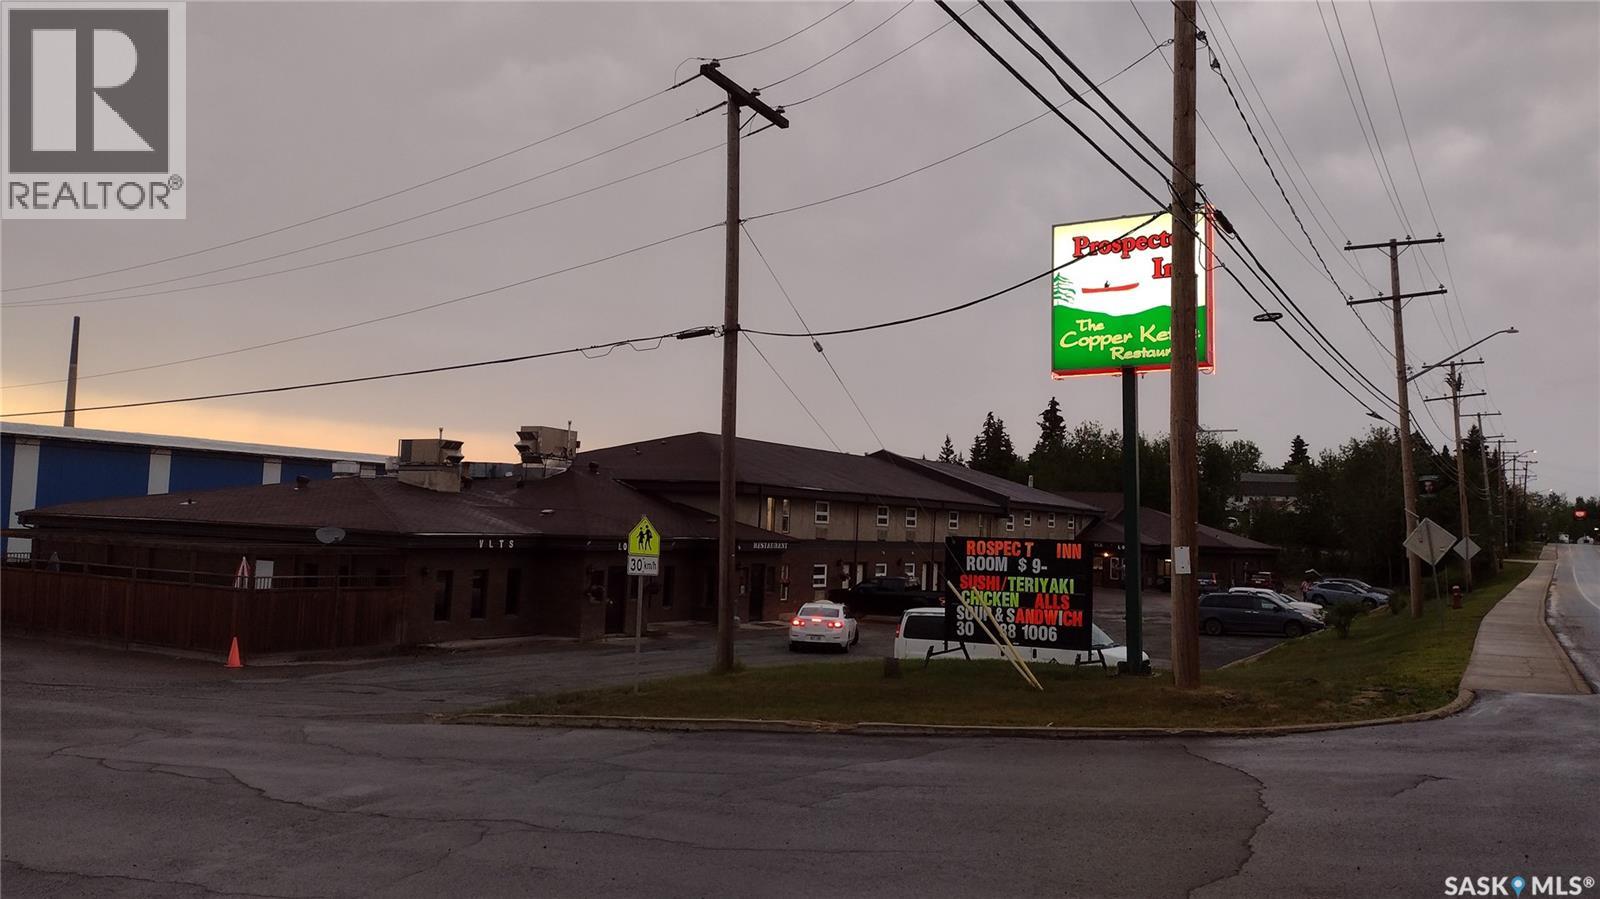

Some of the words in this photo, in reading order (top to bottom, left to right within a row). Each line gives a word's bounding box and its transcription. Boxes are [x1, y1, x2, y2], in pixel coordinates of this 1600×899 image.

[1072, 231, 1172, 258] Prospect
[1152, 257, 1172, 279] In
[1076, 319, 1105, 332] The
[1059, 331, 1134, 351] Copper
[1110, 346, 1171, 360] Restaur
[1056, 543, 1082, 559] INN
[630, 558, 642, 571] 30
[966, 556, 1008, 571] ROOM
[1018, 558, 1027, 572] $
[961, 590, 1020, 607] CHICKEN
[1034, 593, 1070, 610] ALLS
[995, 607, 1004, 622] &
[1006, 608, 1083, 627] SANDWICH
[956, 621, 975, 636] 30
[1022, 625, 1058, 642] 1006
